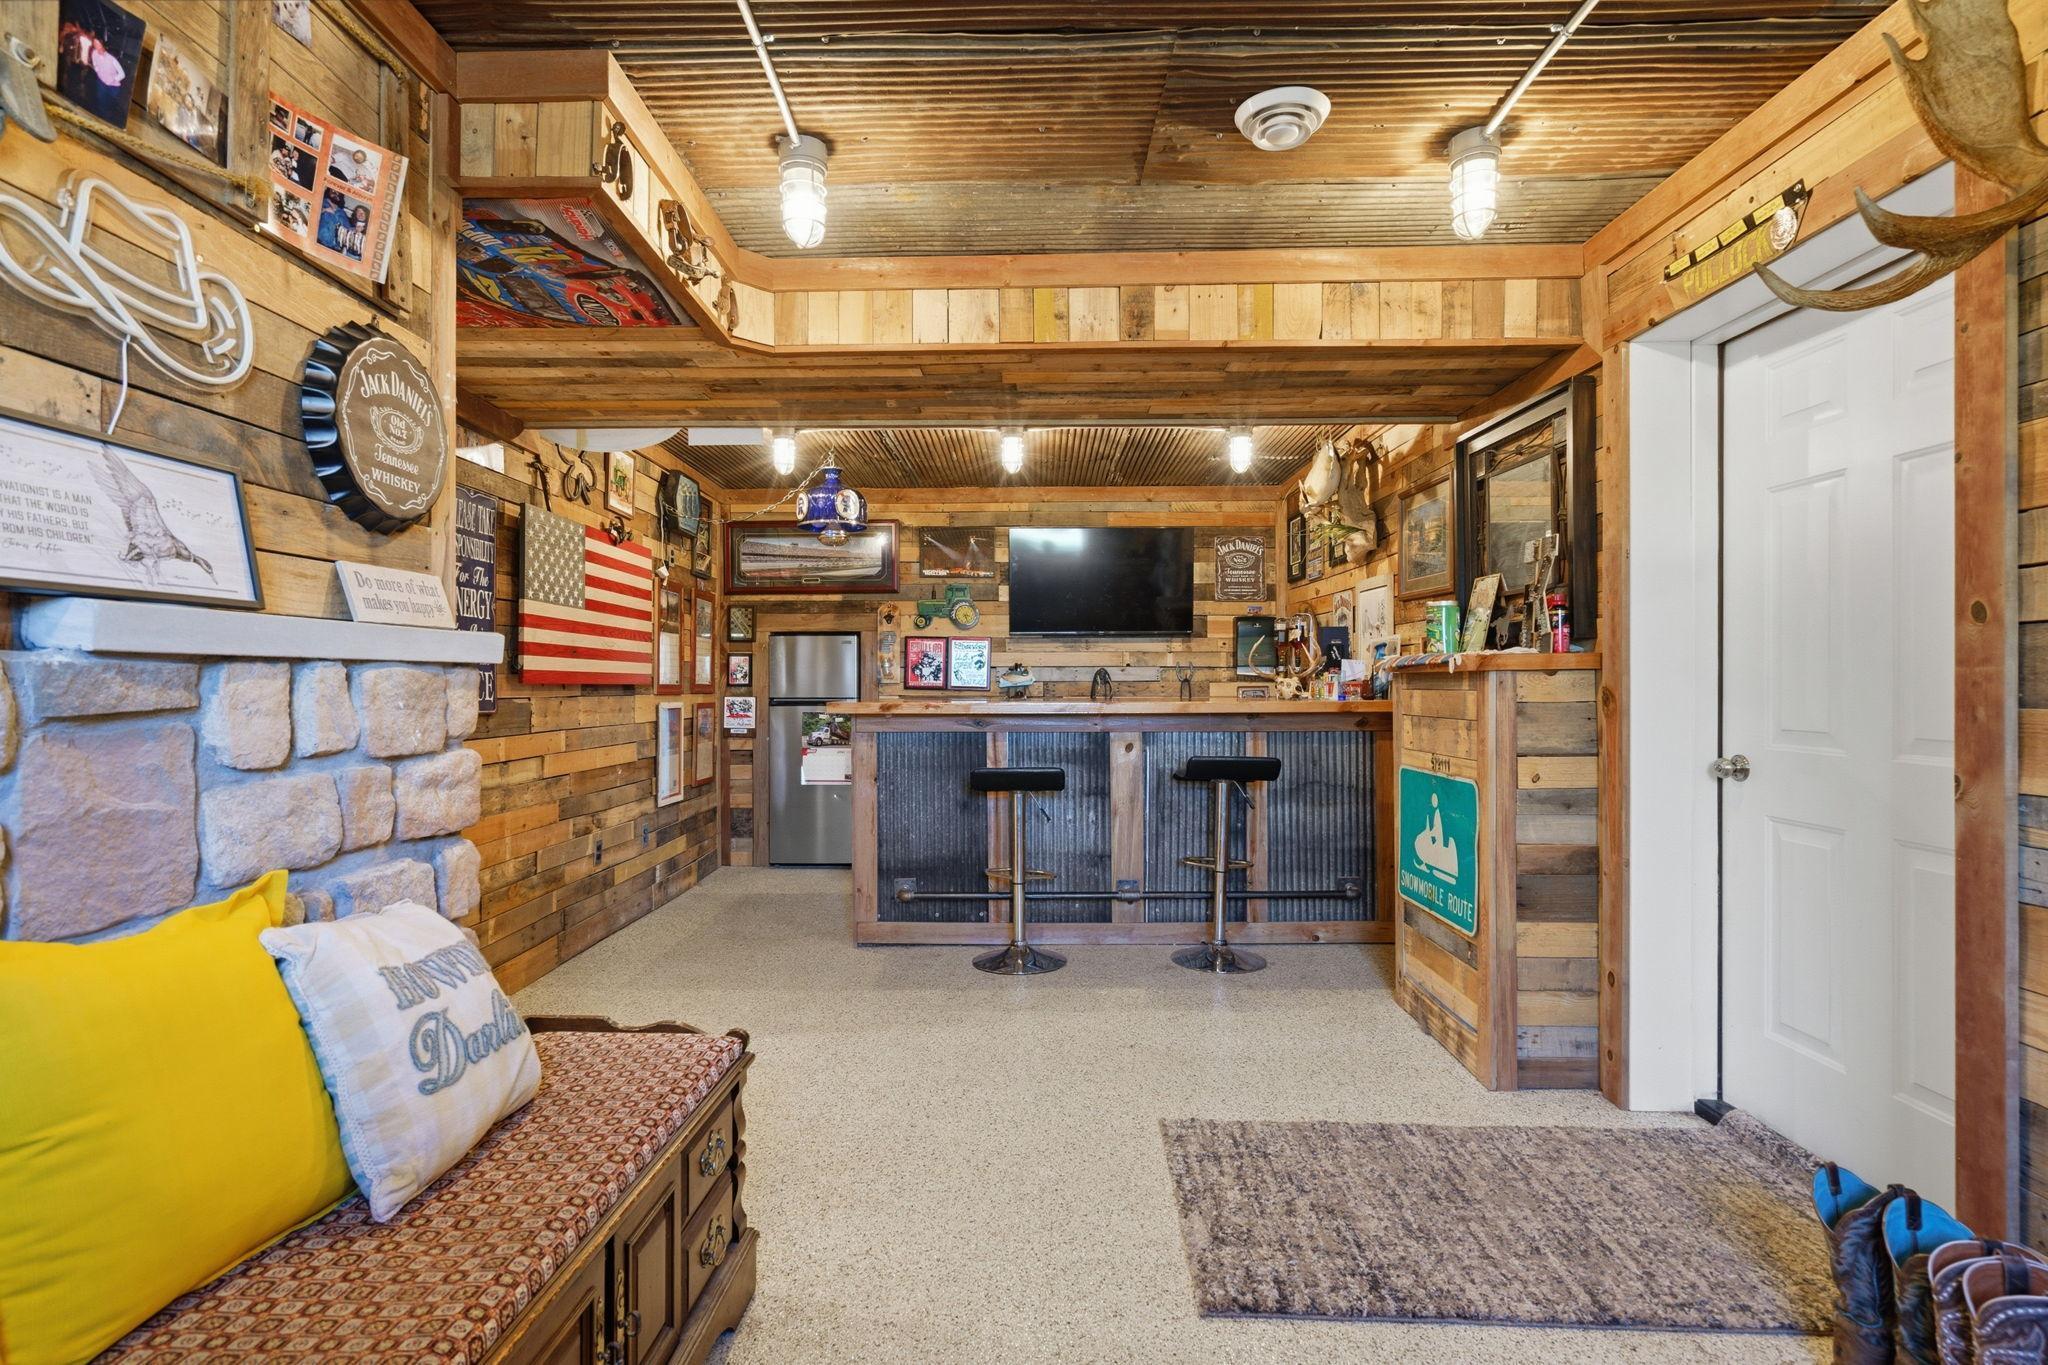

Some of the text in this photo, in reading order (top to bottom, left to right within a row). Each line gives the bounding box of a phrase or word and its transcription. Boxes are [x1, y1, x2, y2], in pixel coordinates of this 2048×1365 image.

[360, 369, 434, 427] JACK DANIEL'S
[374, 443, 420, 475] Tennessee
[371, 466, 421, 495] WHISKEY
[25, 498, 44, 510] THE
[46, 502, 79, 516] WORLD
[80, 508, 89, 519] IS
[52, 489, 62, 500] IS
[64, 491, 71, 501] A
[72, 493, 93, 505] MAN
[7, 509, 24, 521] HIS
[72, 520, 89, 531] BUT
[456, 498, 496, 537] EASE TAKE
[27, 526, 44, 538] HIS
[1217, 542, 1236, 556] JACK
[353, 569, 441, 598] Do more of what
[472, 566, 490, 588] The
[362, 593, 436, 618] makes you happy
[1401, 869, 1473, 923] SNOWMOBILE ROUTE
